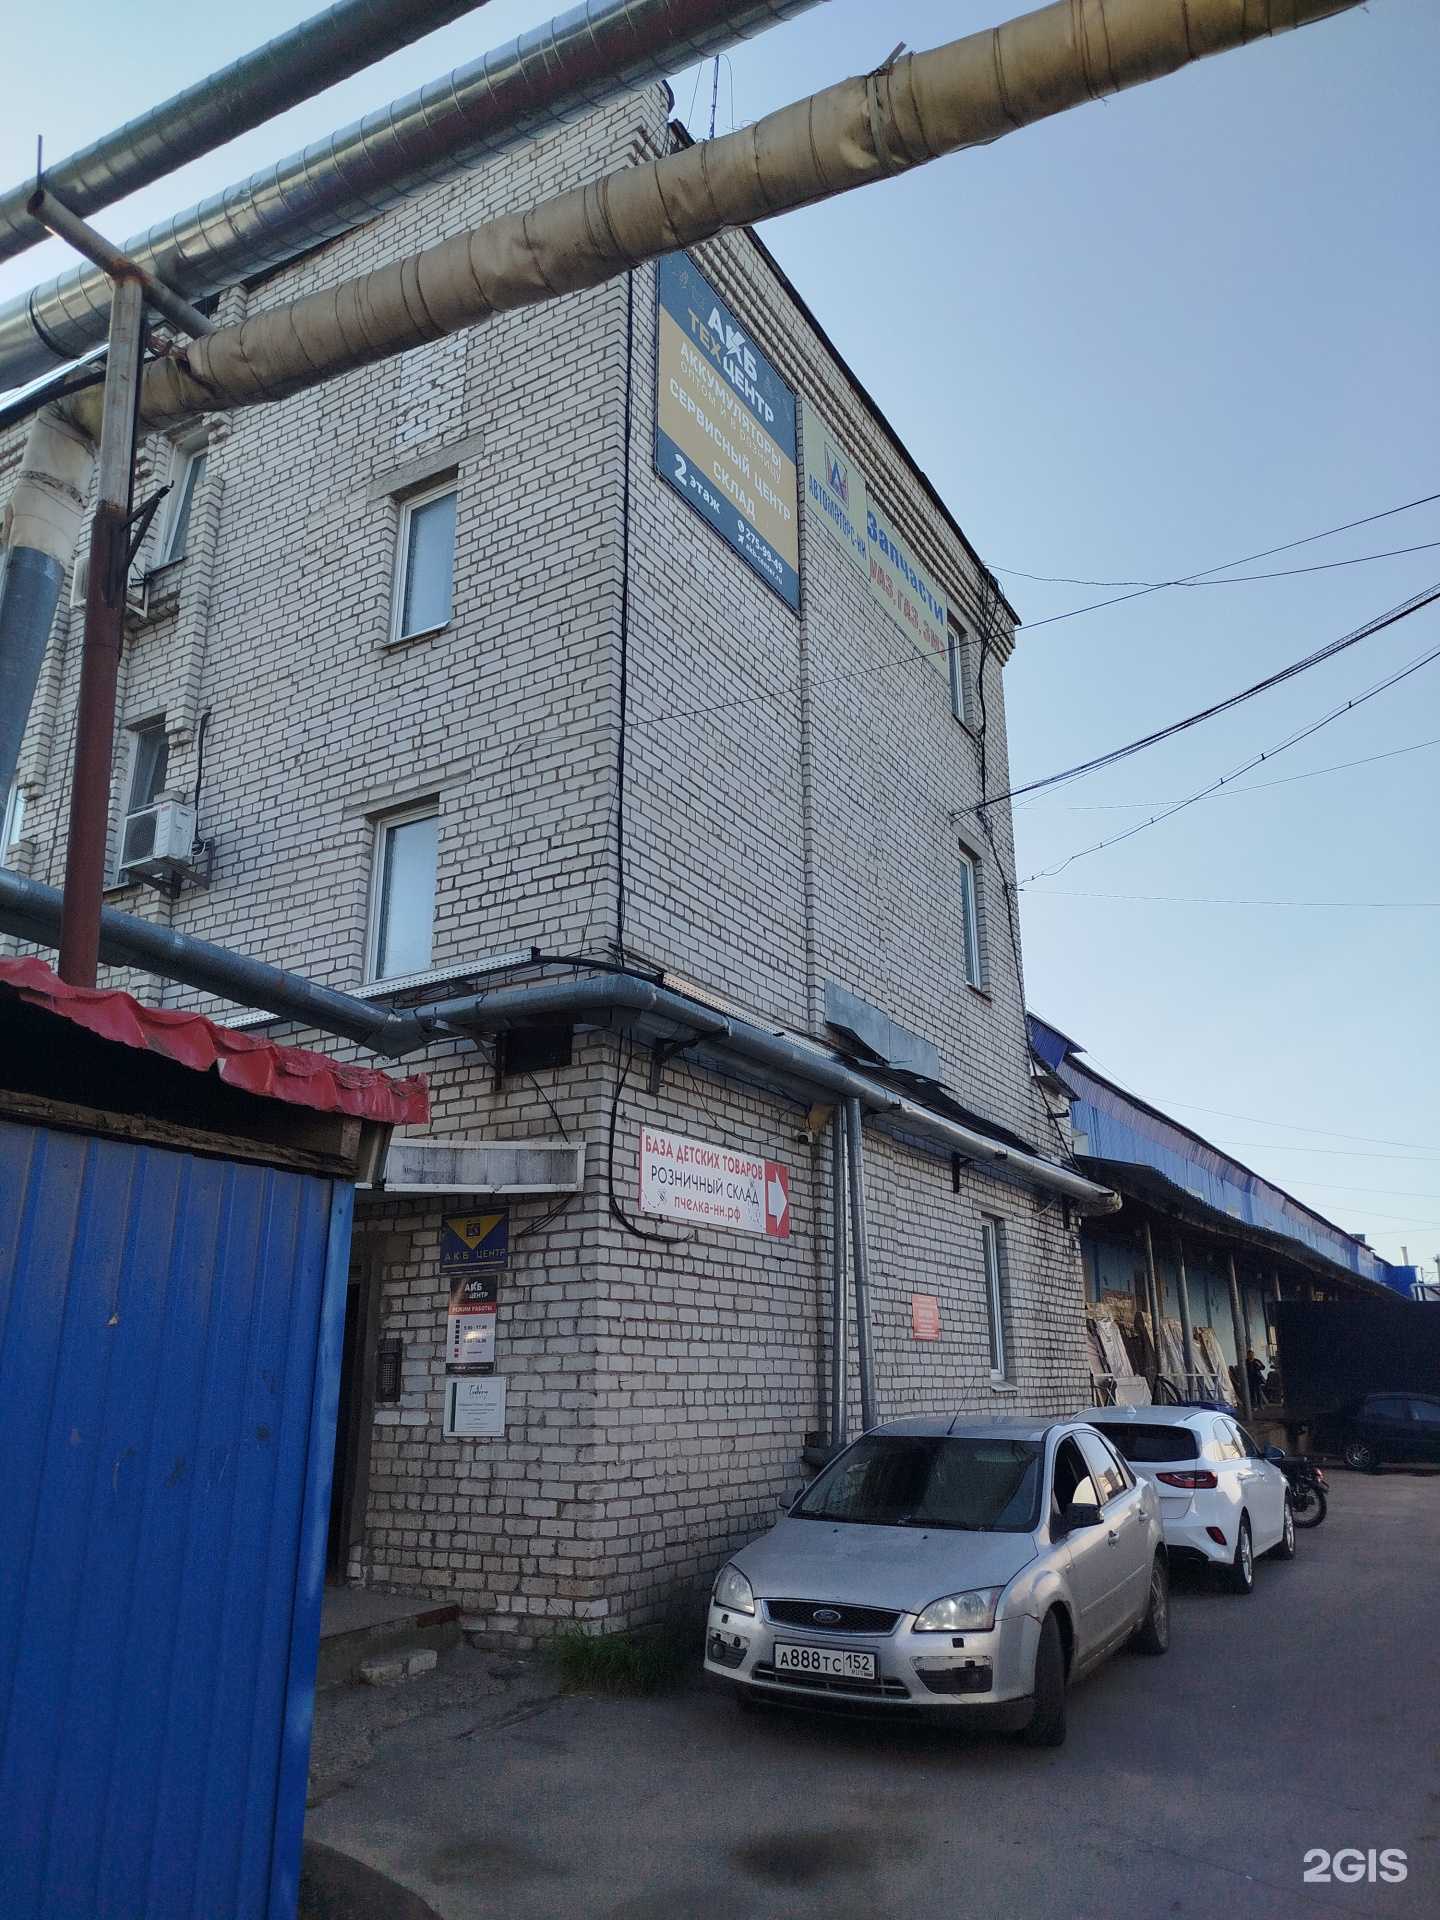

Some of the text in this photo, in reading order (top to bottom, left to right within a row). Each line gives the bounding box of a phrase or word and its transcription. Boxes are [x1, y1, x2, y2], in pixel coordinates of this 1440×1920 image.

[707, 307, 757, 383] АКБ
[680, 341, 782, 471] АККУМУЛЯТОРЫ
[669, 377, 791, 521] СЕРВИСНЫЙ ЦЕНТР
[674, 453, 721, 514] 2 этаж
[713, 460, 756, 522] СКЛАД
[866, 510, 944, 626] Запчасти
[645, 1134, 763, 1181] БАЗА ДЕТСКИХ ТОВАРОВ
[651, 1165, 759, 1209] РОЗНИЧНЫЙ СКЛАД
[674, 1196, 742, 1222] пчелка-нн.рф
[476, 1248, 506, 1259] ЦЕНТР
[465, 1281, 483, 1293] АКБ
[780, 1649, 870, 1673] А888ТС 152
